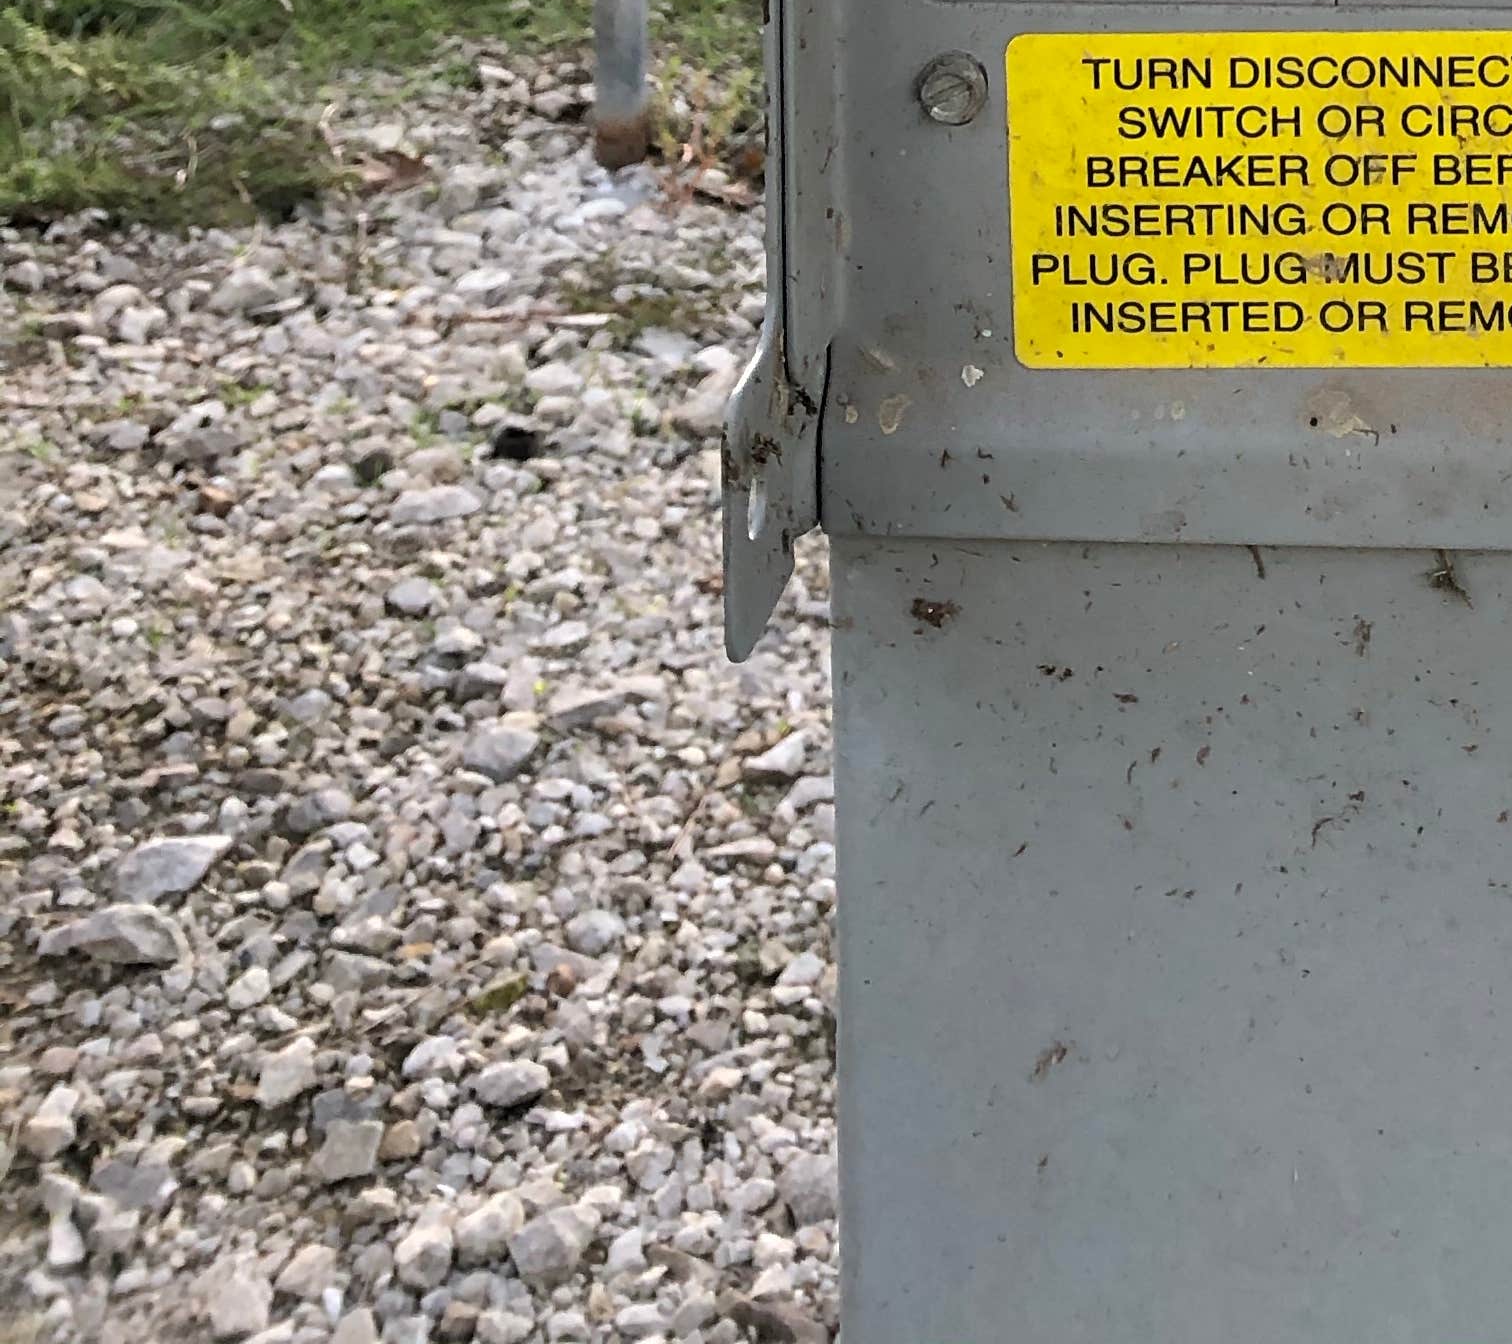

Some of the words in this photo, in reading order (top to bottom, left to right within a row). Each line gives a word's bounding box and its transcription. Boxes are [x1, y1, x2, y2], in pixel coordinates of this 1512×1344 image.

[1083, 58, 1212, 89] TURN
[1118, 106, 1301, 139] SWITCH
[1317, 105, 1385, 138] OR
[1087, 155, 1308, 187] BREAKER
[1326, 155, 1416, 186] OFF
[1055, 203, 1307, 236] INSERTING
[1323, 203, 1390, 236] OR
[1032, 252, 1167, 285] PLUG.
[1185, 252, 1307, 285] PLUG
[1326, 252, 1455, 285] MUST
[1072, 301, 1304, 333] INSERTED
[1320, 301, 1387, 333] OR
